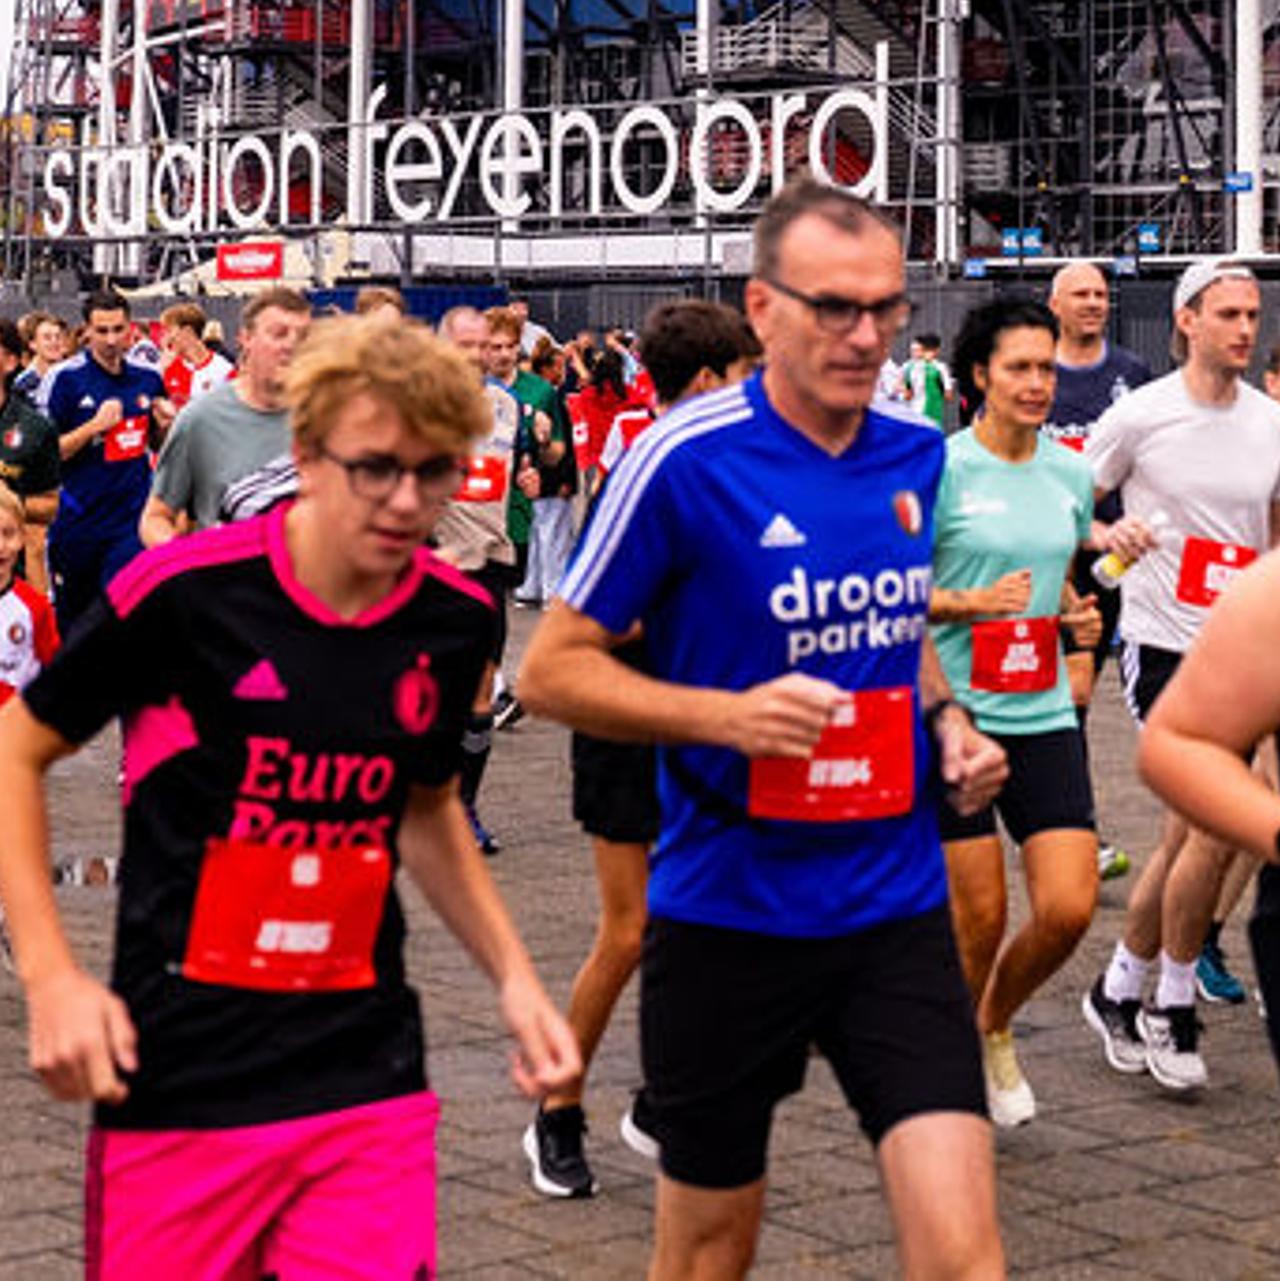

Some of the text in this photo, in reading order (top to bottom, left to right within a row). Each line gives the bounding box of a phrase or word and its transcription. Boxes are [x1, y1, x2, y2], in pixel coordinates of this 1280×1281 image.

[41, 40, 890, 238] stadion feyenoord
[238, 735, 394, 804] Euro
